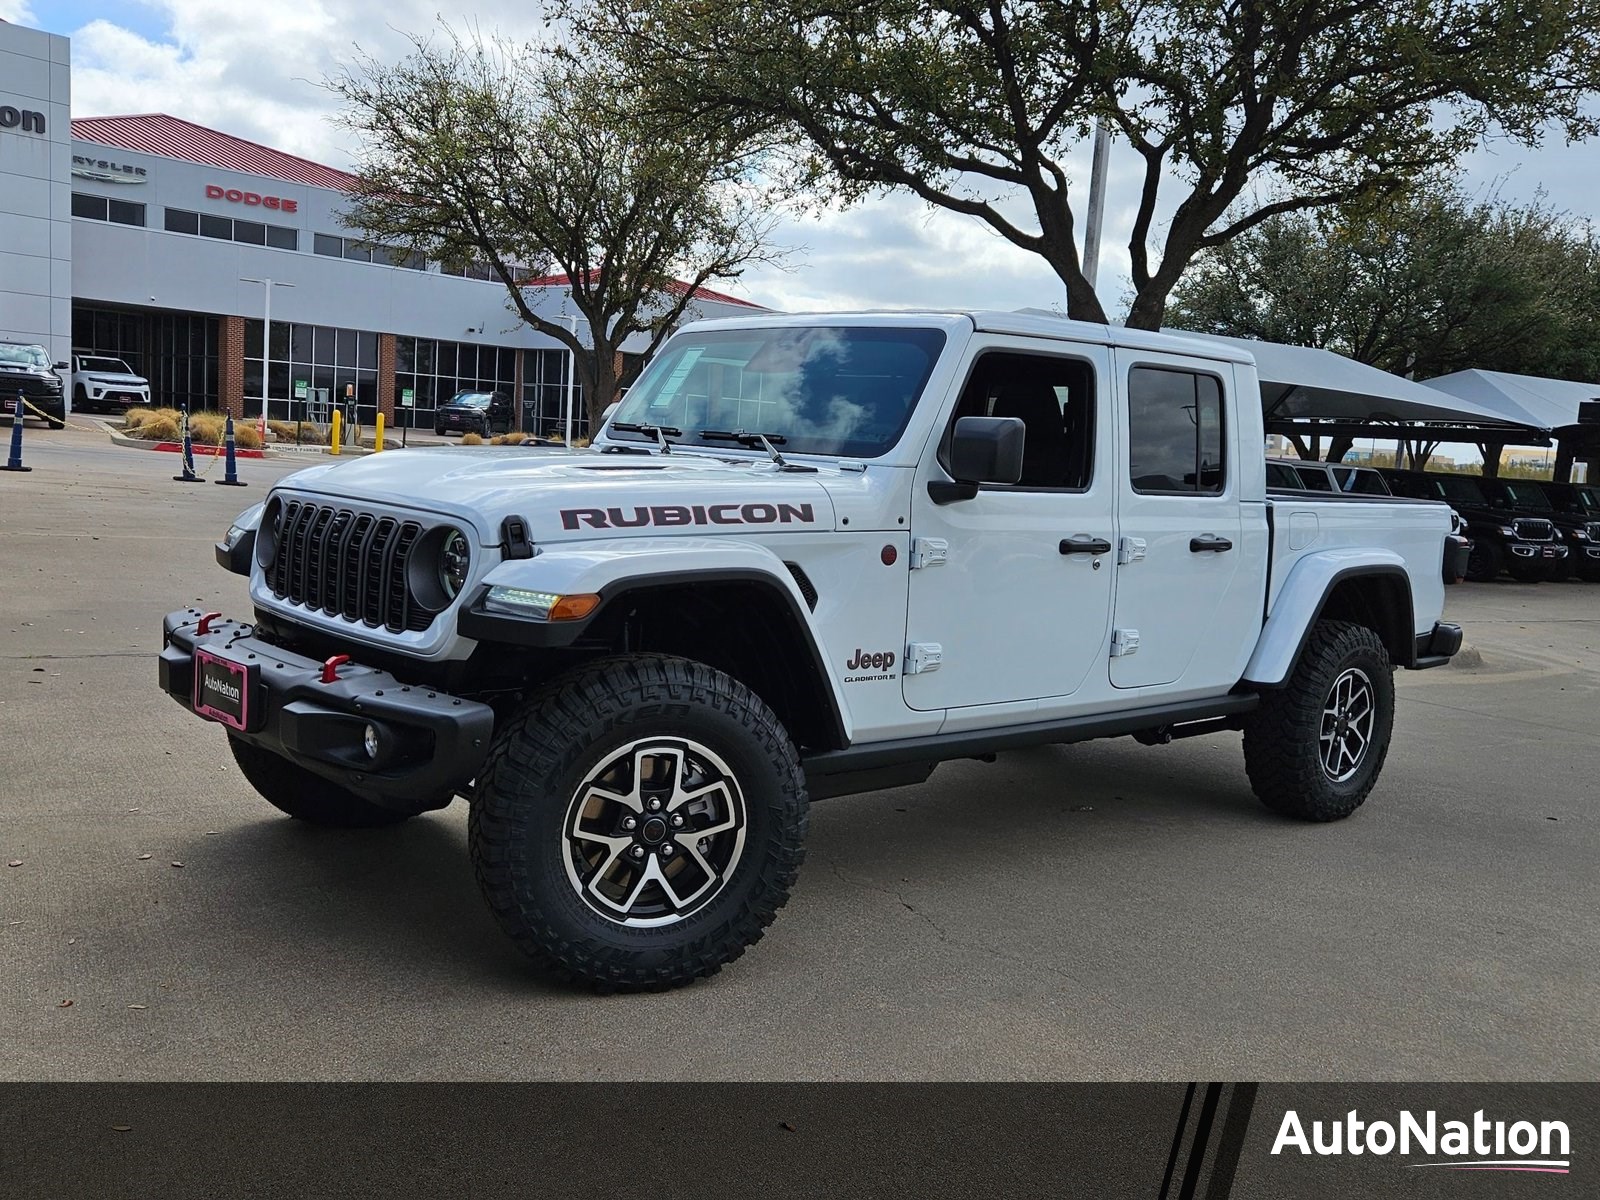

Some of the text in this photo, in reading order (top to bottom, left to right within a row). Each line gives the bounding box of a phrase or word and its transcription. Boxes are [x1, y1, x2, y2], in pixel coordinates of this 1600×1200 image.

[205, 184, 298, 213] DODGE
[560, 503, 814, 530] RUBICON
[847, 649, 896, 671] Jeep
[204, 673, 240, 699] AutoNation
[844, 675, 888, 683] GLADIATOR
